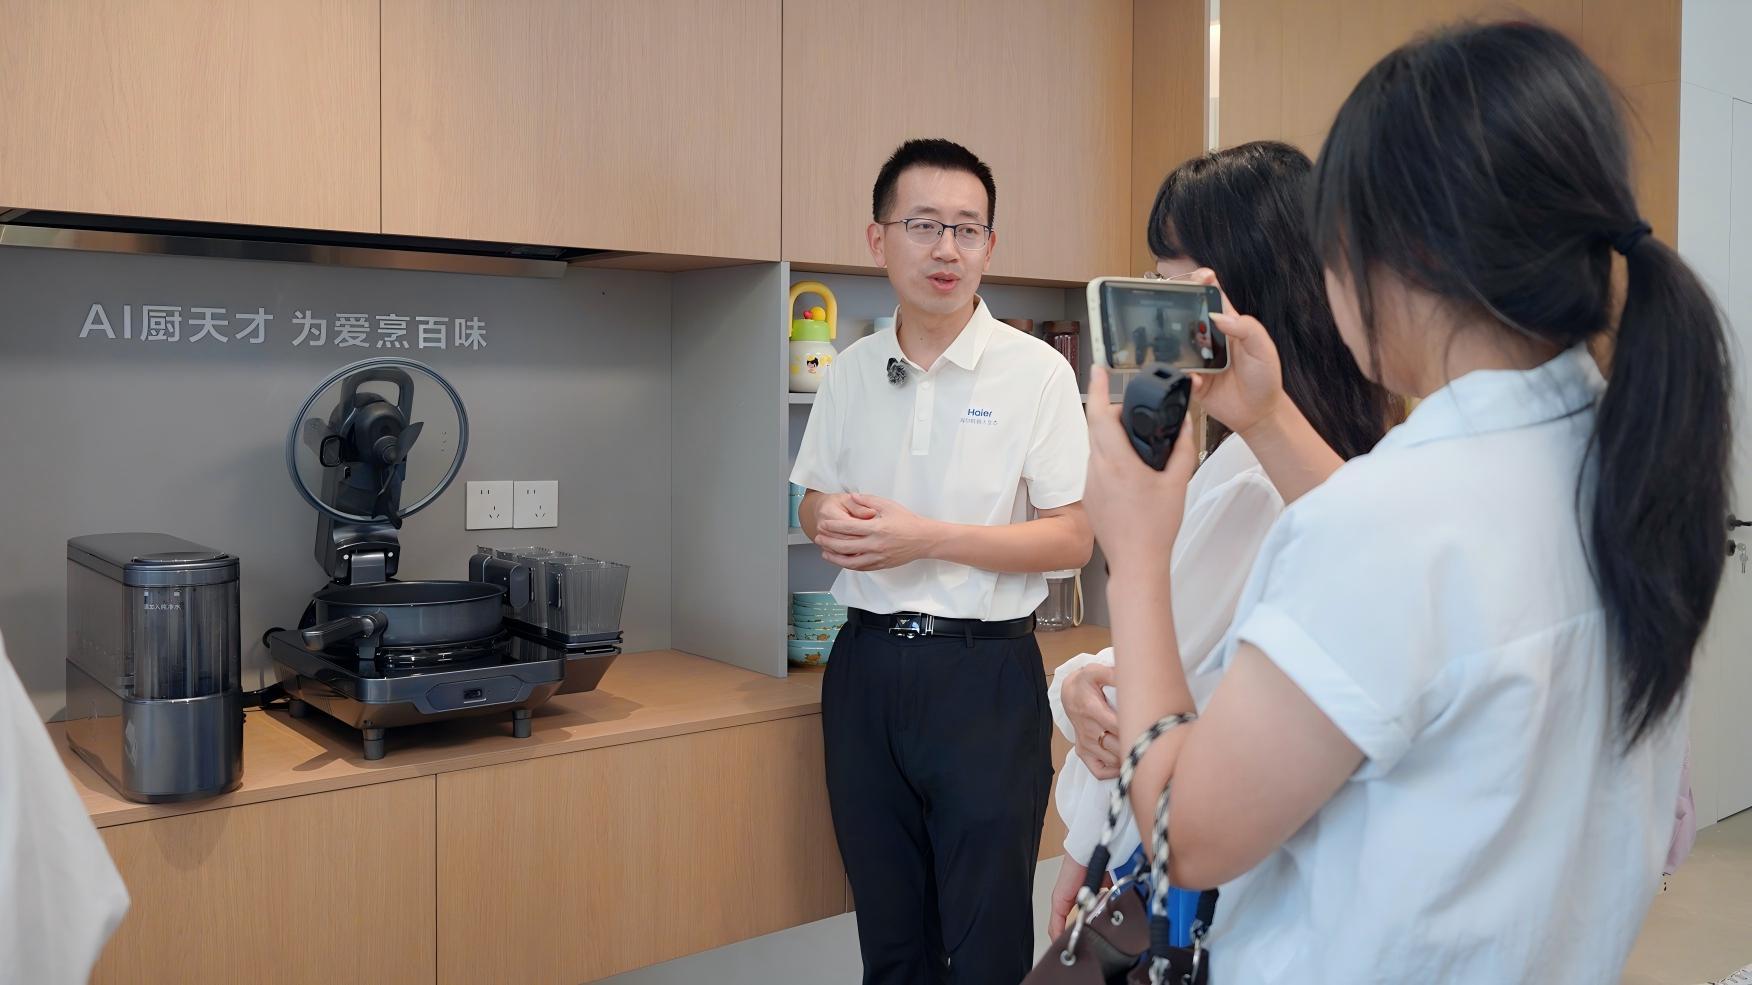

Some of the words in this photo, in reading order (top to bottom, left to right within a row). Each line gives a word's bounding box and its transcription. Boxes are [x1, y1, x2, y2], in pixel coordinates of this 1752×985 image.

[79, 303, 274, 344] AI厨天才
[291, 310, 488, 350] 为爱烹百味
[967, 408, 992, 417] Haier
